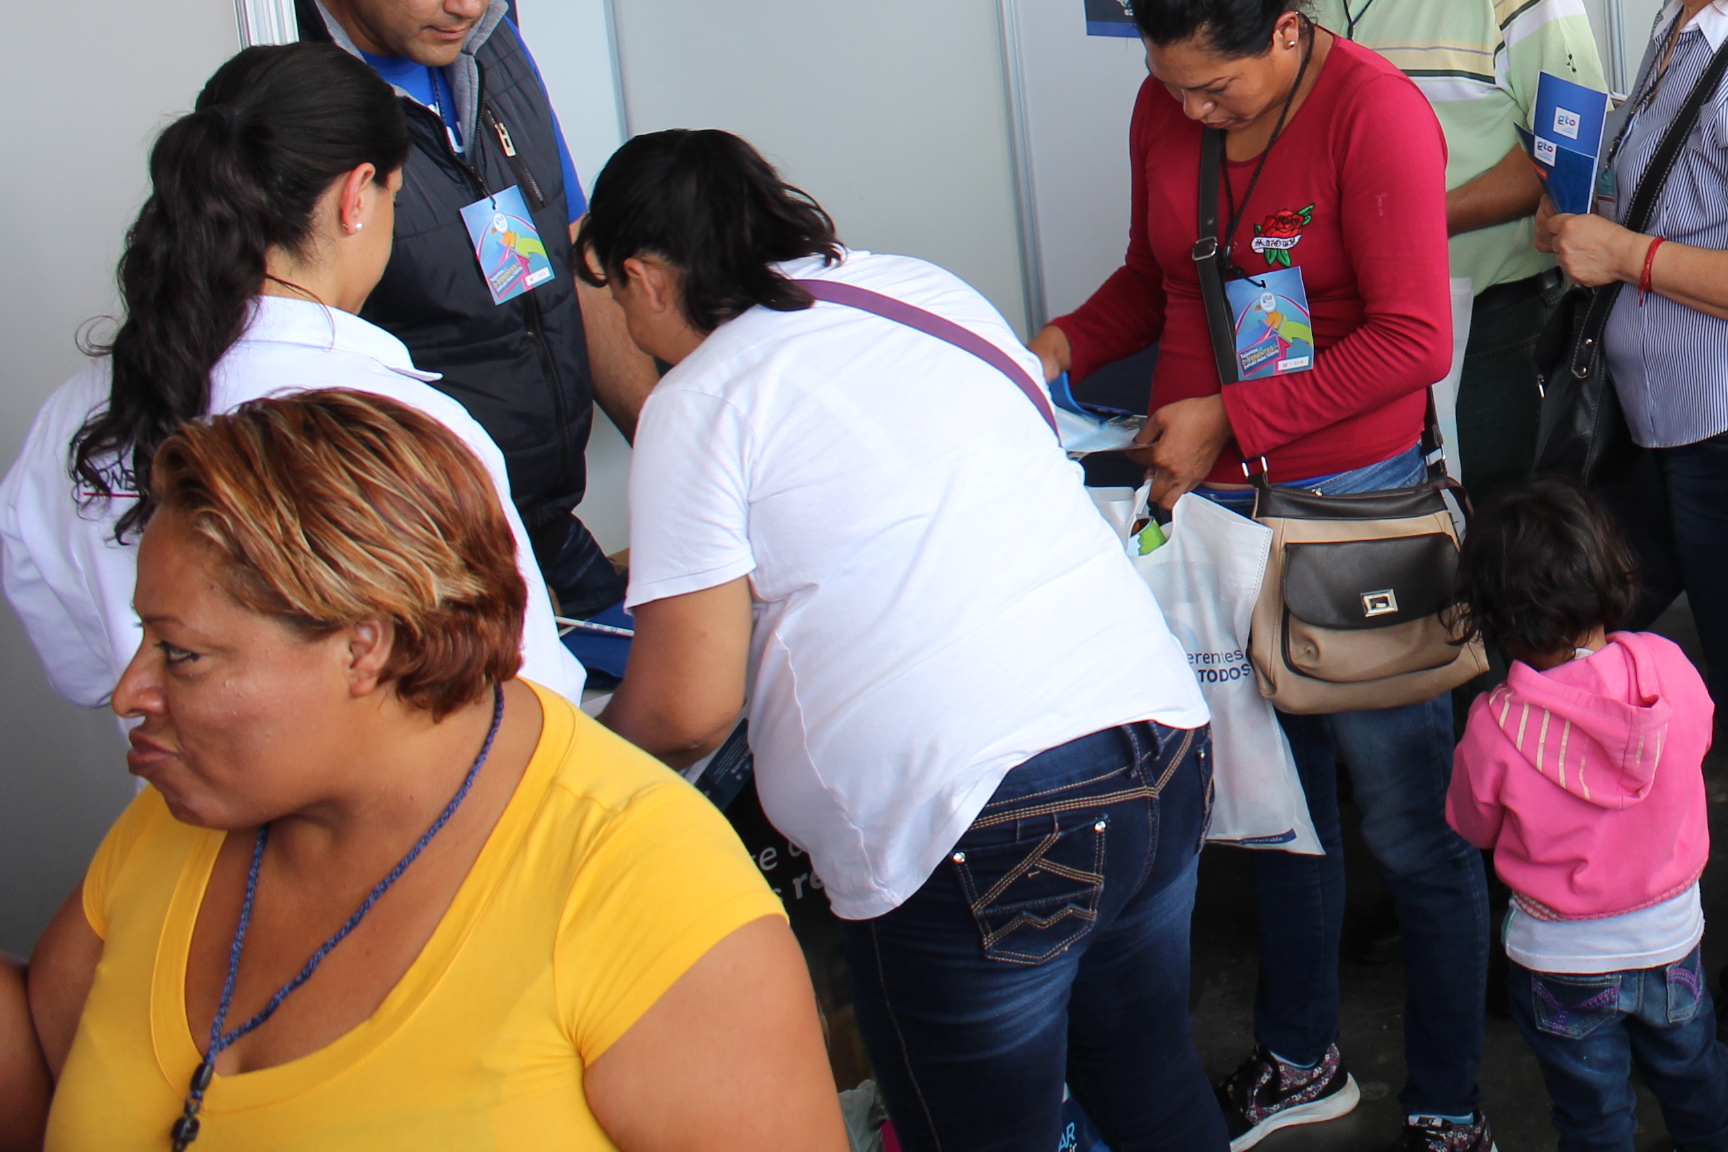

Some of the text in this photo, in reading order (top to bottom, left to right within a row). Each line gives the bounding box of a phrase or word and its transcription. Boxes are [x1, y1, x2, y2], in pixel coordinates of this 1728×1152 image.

[1557, 114, 1576, 127] gto
[1537, 142, 1554, 153] gto
[1186, 649, 1244, 664] erentes
[1198, 663, 1251, 683] TODOS
